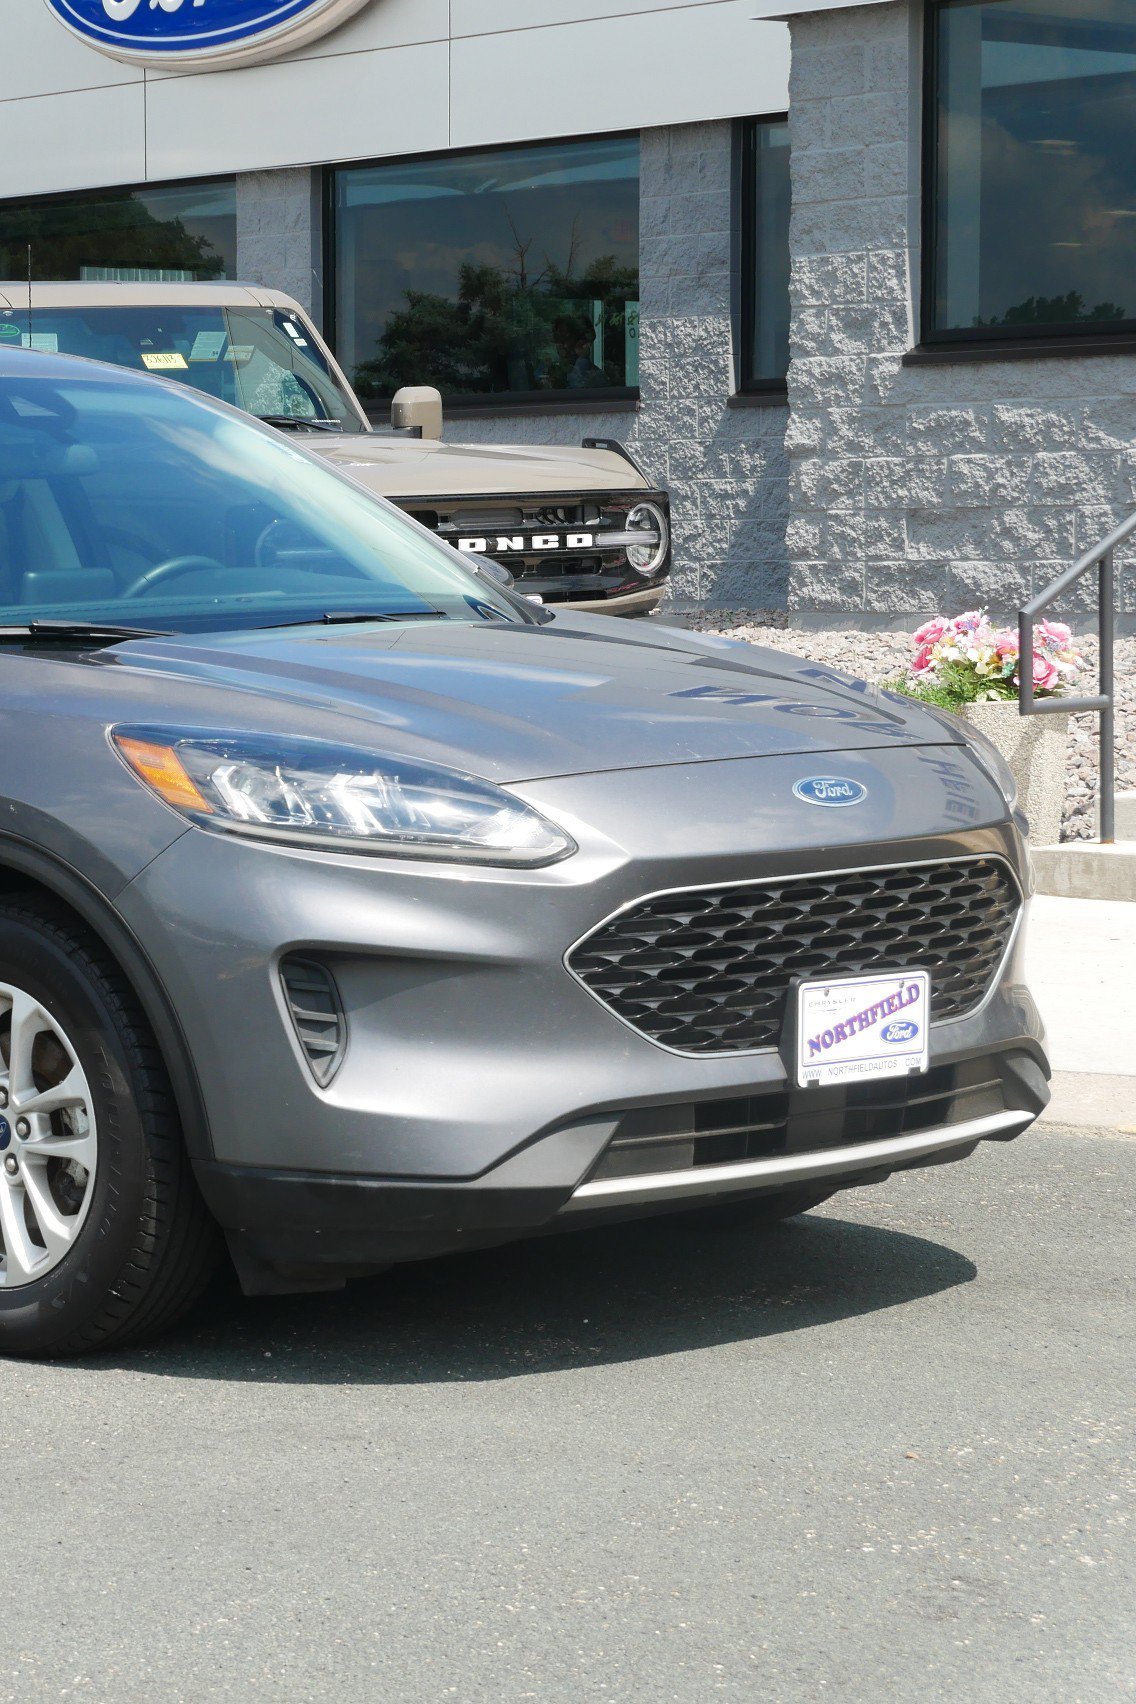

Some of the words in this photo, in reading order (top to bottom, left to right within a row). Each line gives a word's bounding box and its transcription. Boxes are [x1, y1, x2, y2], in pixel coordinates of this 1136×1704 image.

[444, 533, 593, 552] ONCO
[812, 779, 853, 798] Ford
[807, 983, 920, 1057] NORTHFIELD
[886, 1022, 913, 1040] Ford
